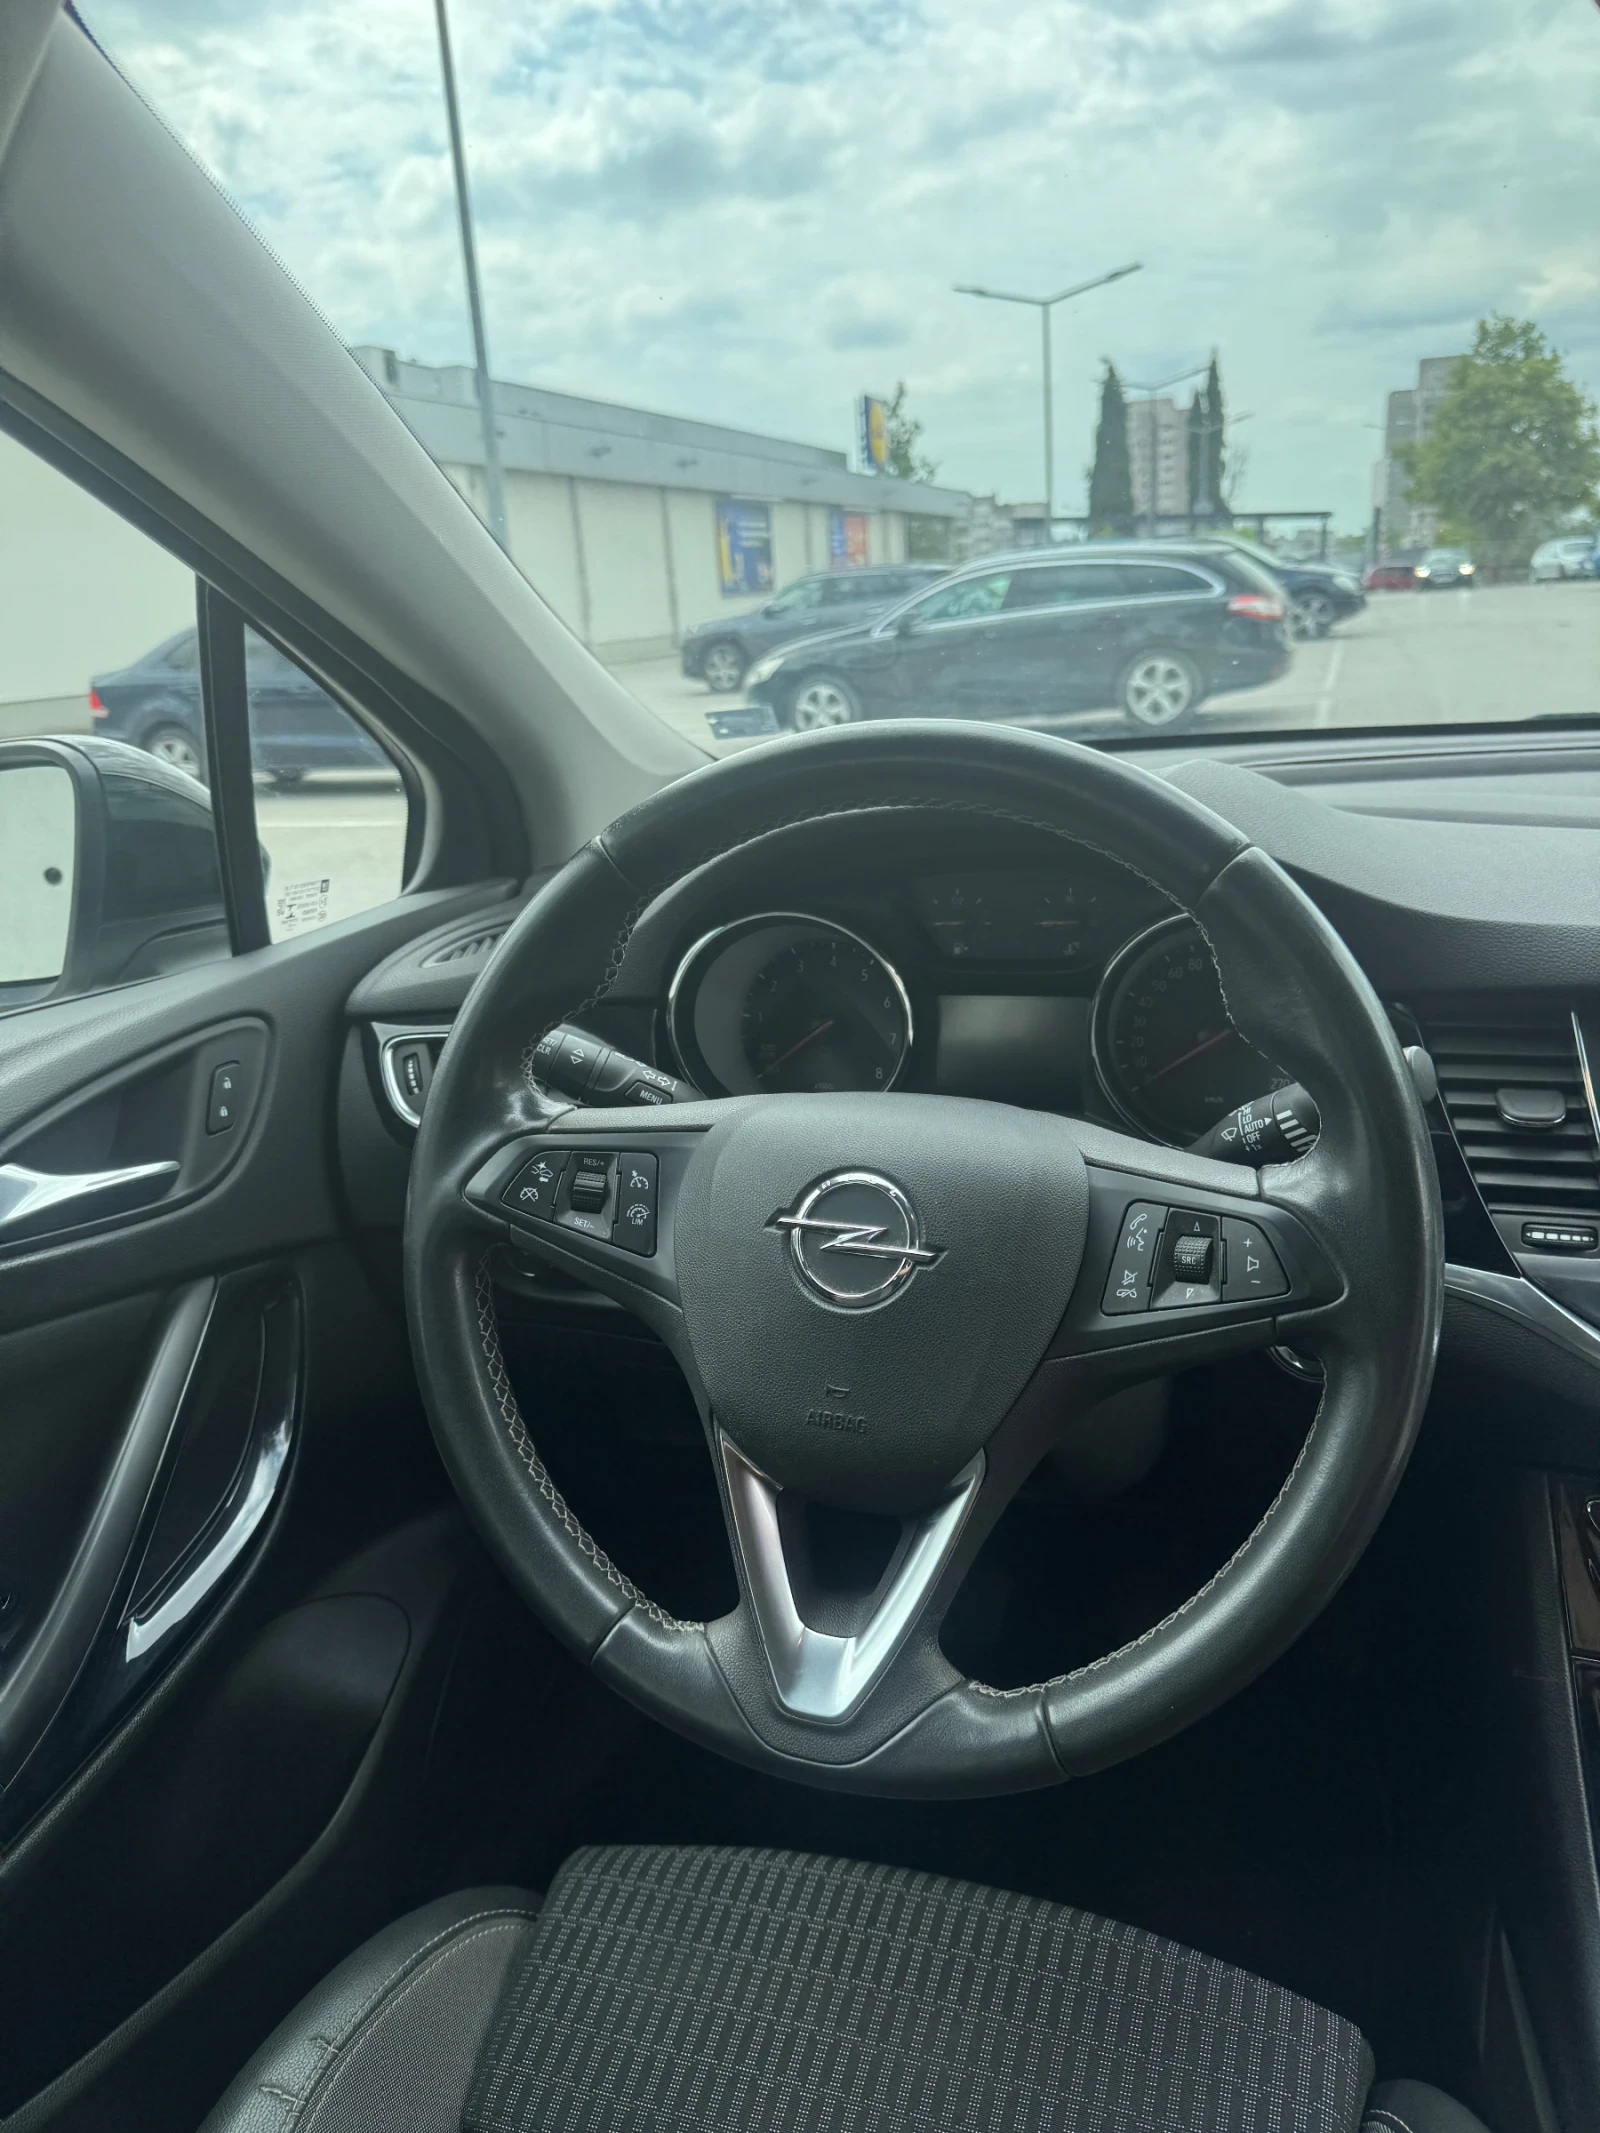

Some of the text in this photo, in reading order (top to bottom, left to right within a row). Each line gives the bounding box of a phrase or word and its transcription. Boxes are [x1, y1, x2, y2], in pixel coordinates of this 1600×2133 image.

[796, 960, 804, 972] 3
[830, 956, 837, 967] 4
[1188, 958, 1203, 971] 80
[861, 969, 869, 981] 5
[1168, 967, 1184, 979] 60
[771, 981, 778, 992] 2
[884, 996, 891, 1008] 6
[889, 1033, 897, 1045] 7
[537, 1044, 552, 1055] CLR
[876, 1067, 883, 1079] 8
[1270, 1078, 1290, 1090] 270
[640, 1090, 663, 1105] MENU
[1242, 1114, 1252, 1124] LO
[1244, 1119, 1264, 1134] AUTO
[1246, 1131, 1261, 1143] OFF
[583, 1157, 605, 1166] RES/+
[632, 1217, 643, 1226] LIM
[1181, 1255, 1197, 1265] SRC
[806, 1408, 868, 1434] AIRBAG
